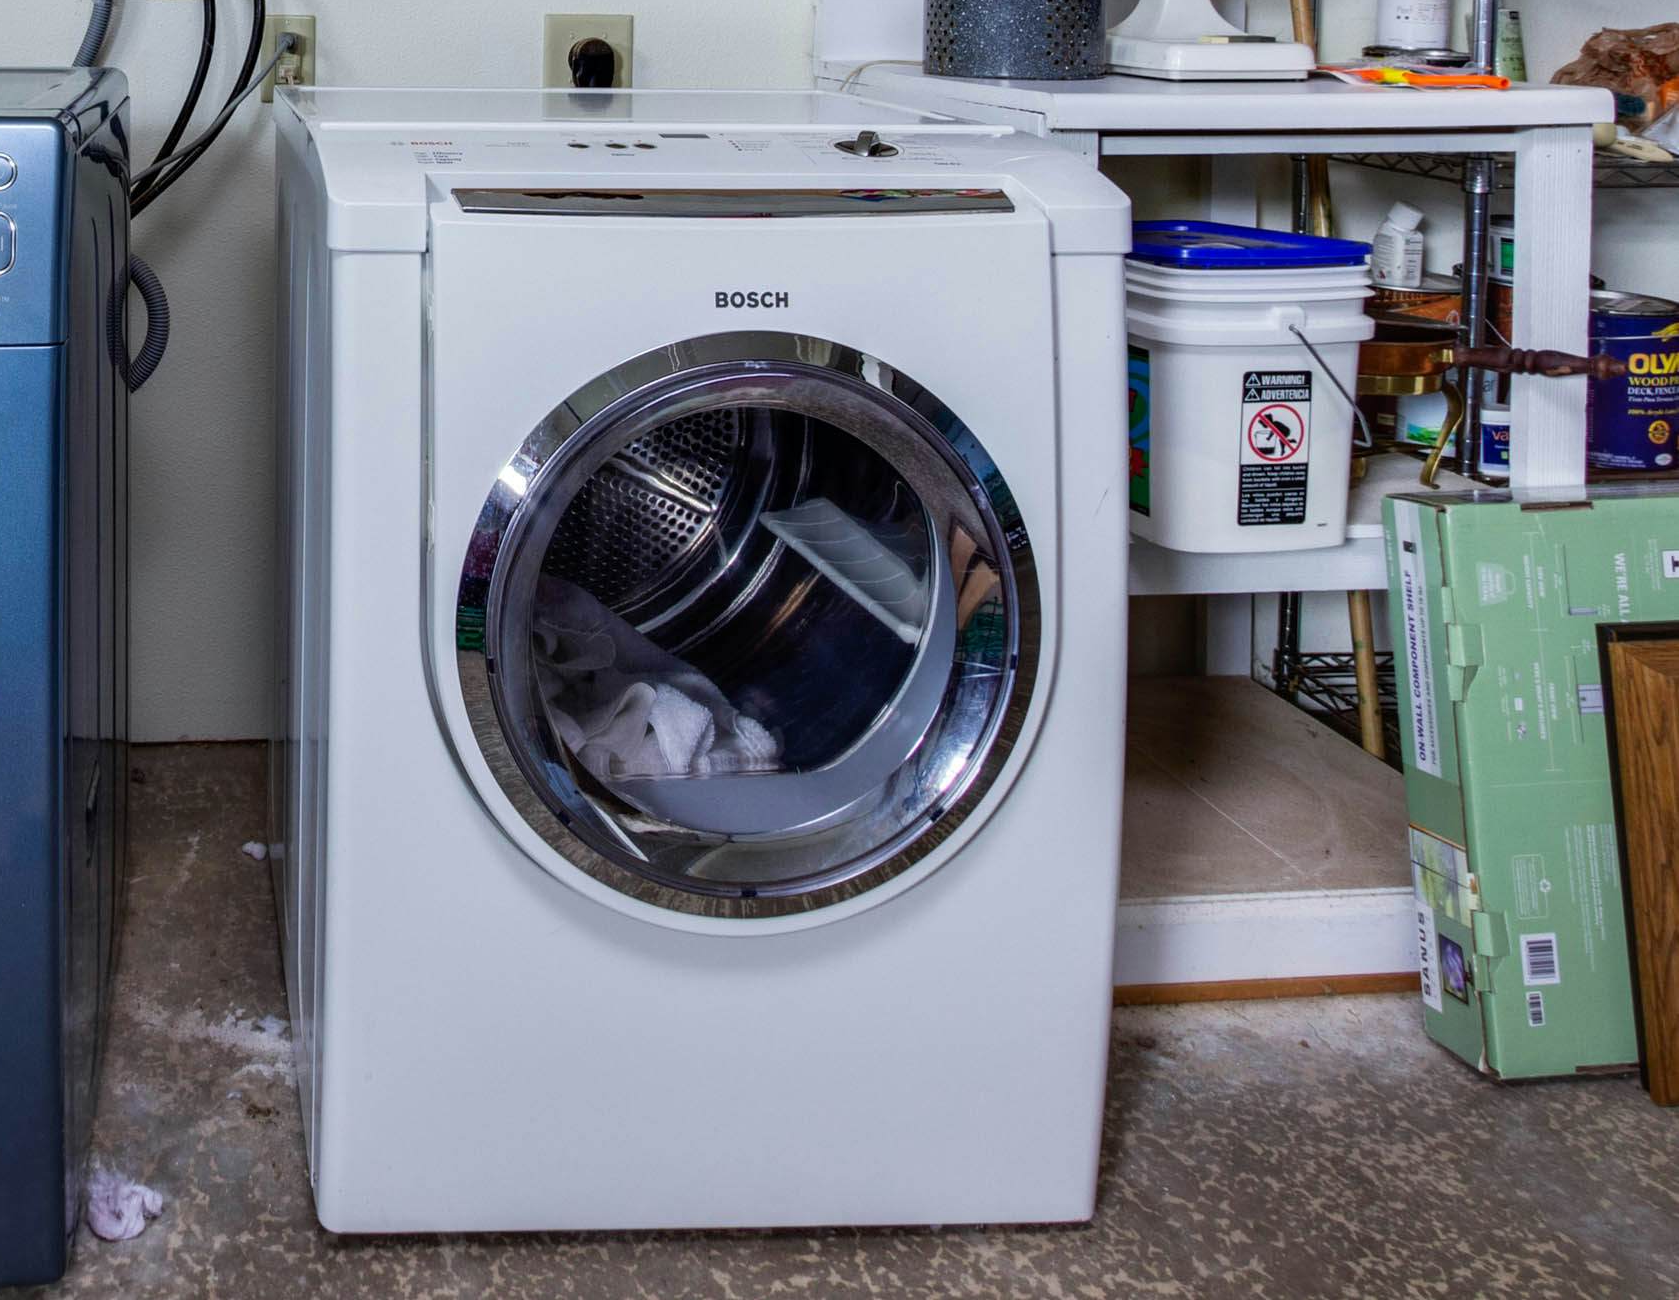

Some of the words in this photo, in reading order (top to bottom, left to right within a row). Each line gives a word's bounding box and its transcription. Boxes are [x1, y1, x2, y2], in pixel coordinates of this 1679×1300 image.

[715, 291, 789, 309] BOSCH
[1627, 376, 1668, 386] WOOD
[1403, 569, 1414, 613] SHELF
[1613, 552, 1629, 591] WE'RE
[1617, 594, 1631, 616] ALL
[1408, 614, 1422, 698] COMPONENT
[1415, 702, 1427, 762] ON-WALL
[1417, 911, 1431, 997] SANUS
